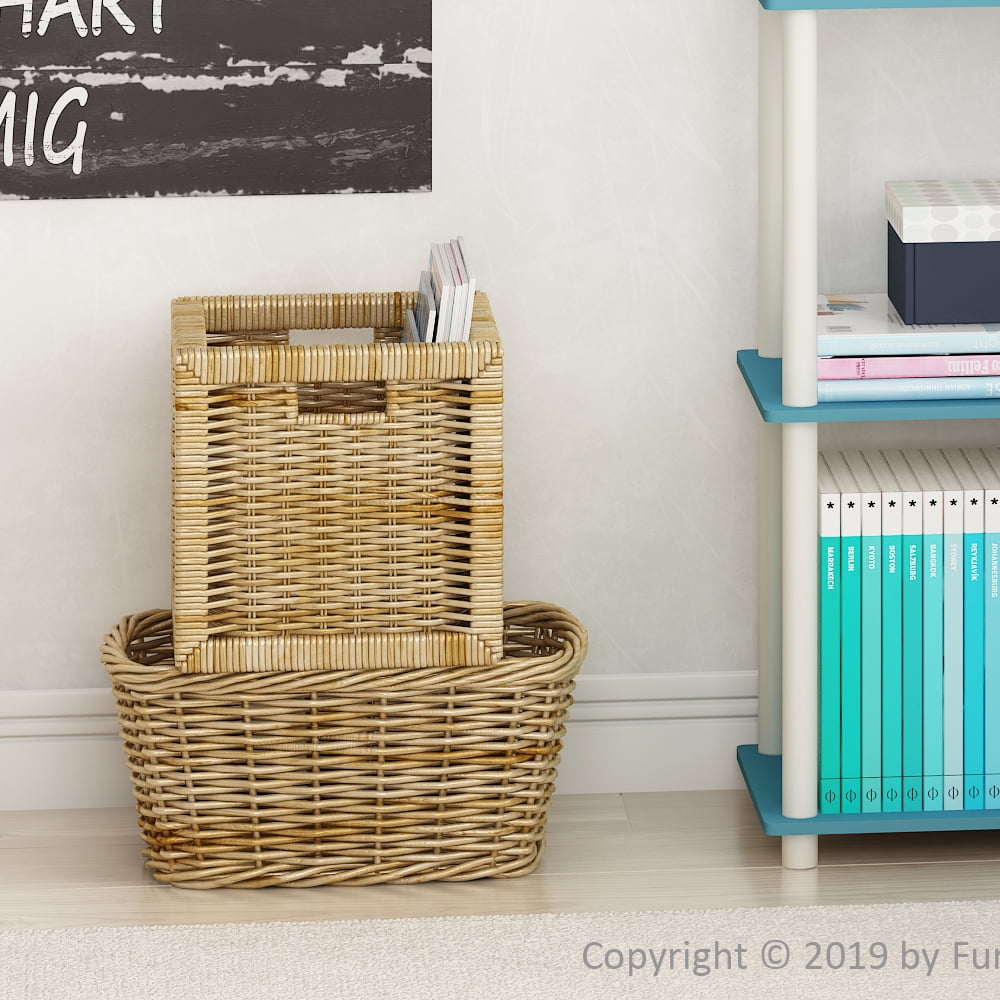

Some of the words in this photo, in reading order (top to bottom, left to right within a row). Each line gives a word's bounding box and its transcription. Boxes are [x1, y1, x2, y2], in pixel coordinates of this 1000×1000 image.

[0, 86, 88, 175] IG
[947, 359, 989, 376] Fellini
[827, 546, 835, 590] MARRAKECH
[847, 546, 855, 572] BERLIN
[868, 545, 876, 570] KYOTO
[888, 545, 896, 574] BOSTON
[909, 544, 917, 581] SALZBURG
[991, 542, 999, 598] JOHANNESBURG
